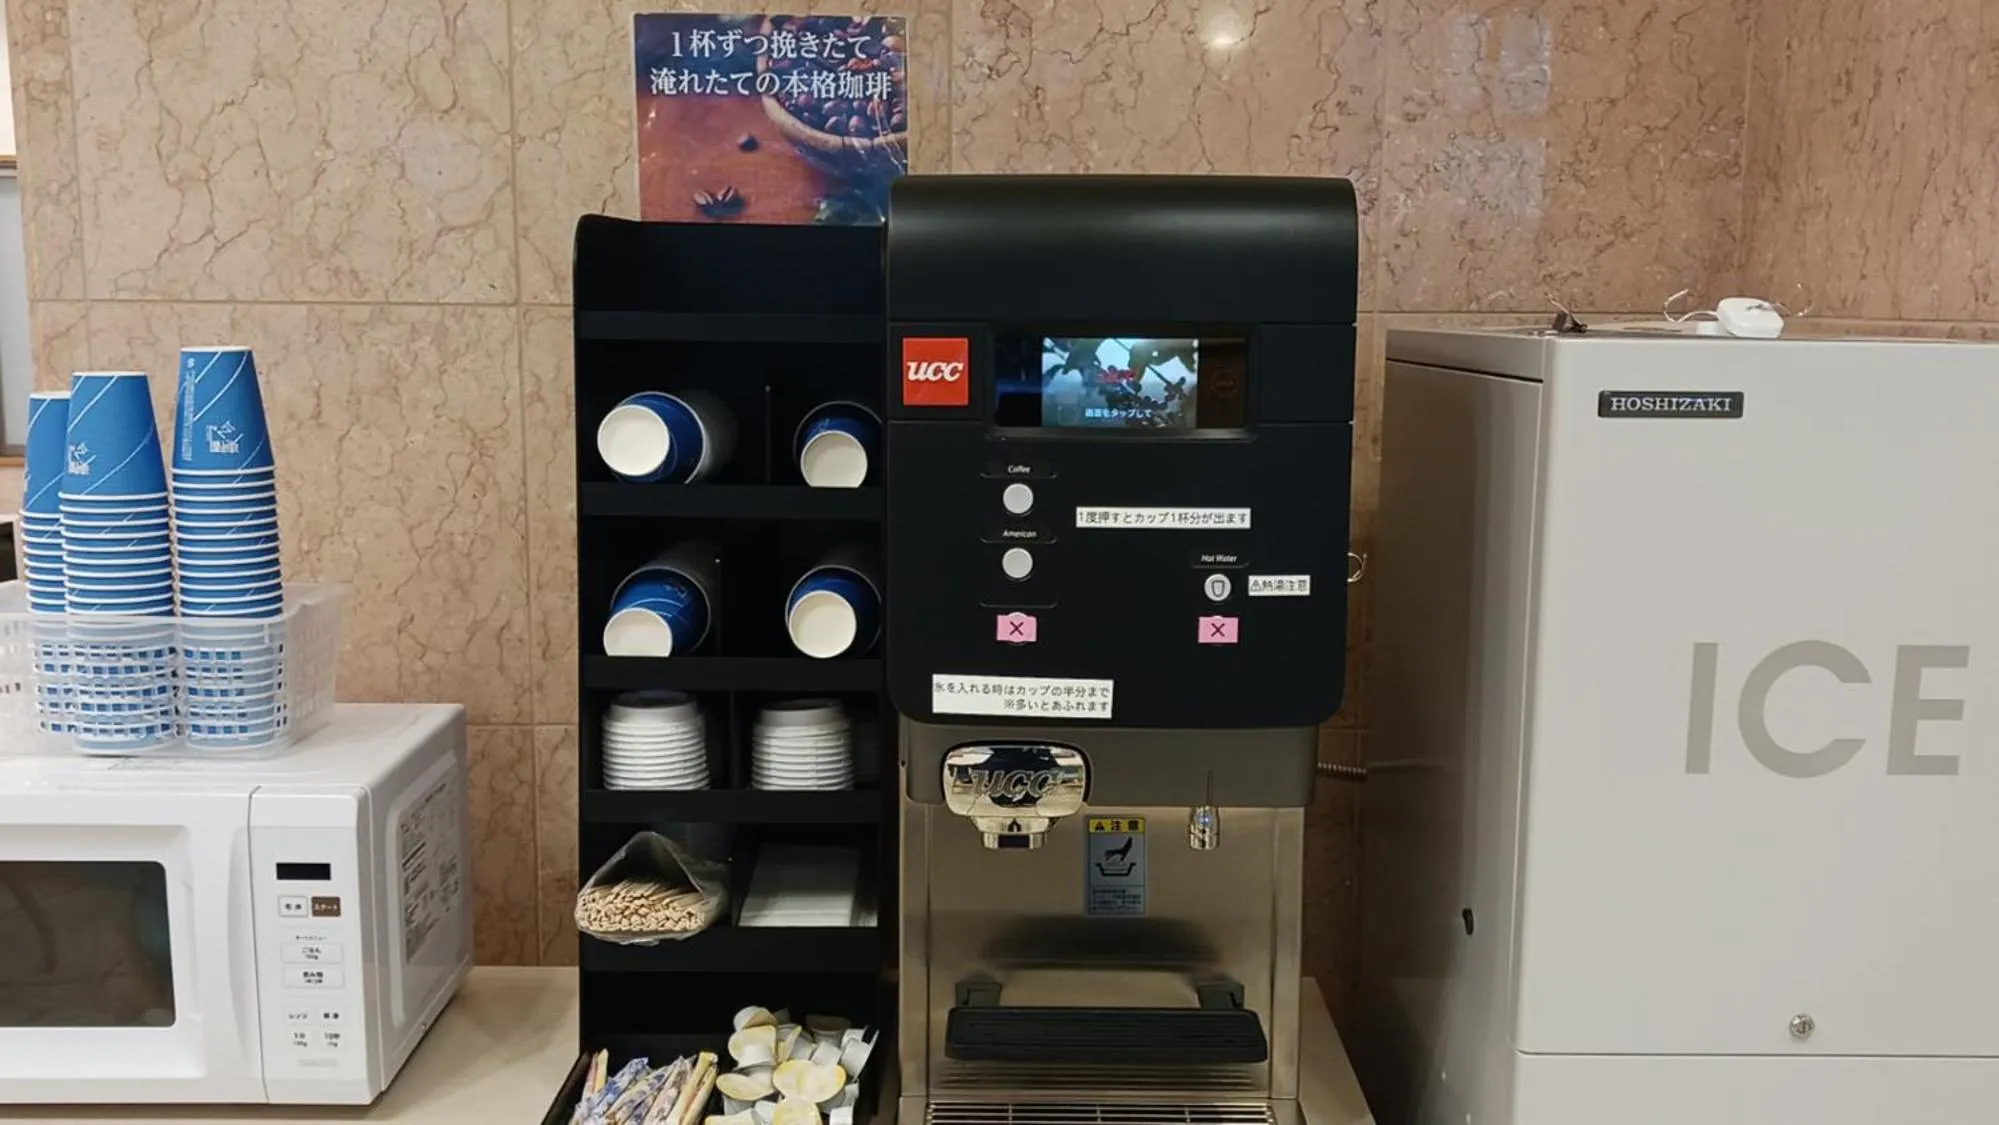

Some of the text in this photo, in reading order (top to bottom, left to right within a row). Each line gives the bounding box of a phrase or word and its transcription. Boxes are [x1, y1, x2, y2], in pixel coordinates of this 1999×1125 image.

[671, 29, 871, 59] 1杯ずつ挽きたて
[650, 68, 892, 99] 淹れたての本格珈琲
[1610, 396, 1731, 411] HOSHIZAKI
[1007, 464, 1031, 474] Coffee
[1078, 511, 1248, 525] 1度押すとカップ1杯分が出ます
[1002, 529, 1037, 538] American
[1200, 554, 1237, 563] Hot Water
[934, 682, 1110, 698] 氷を入れる時はカップの半分まで
[1685, 640, 1970, 778] ICE
